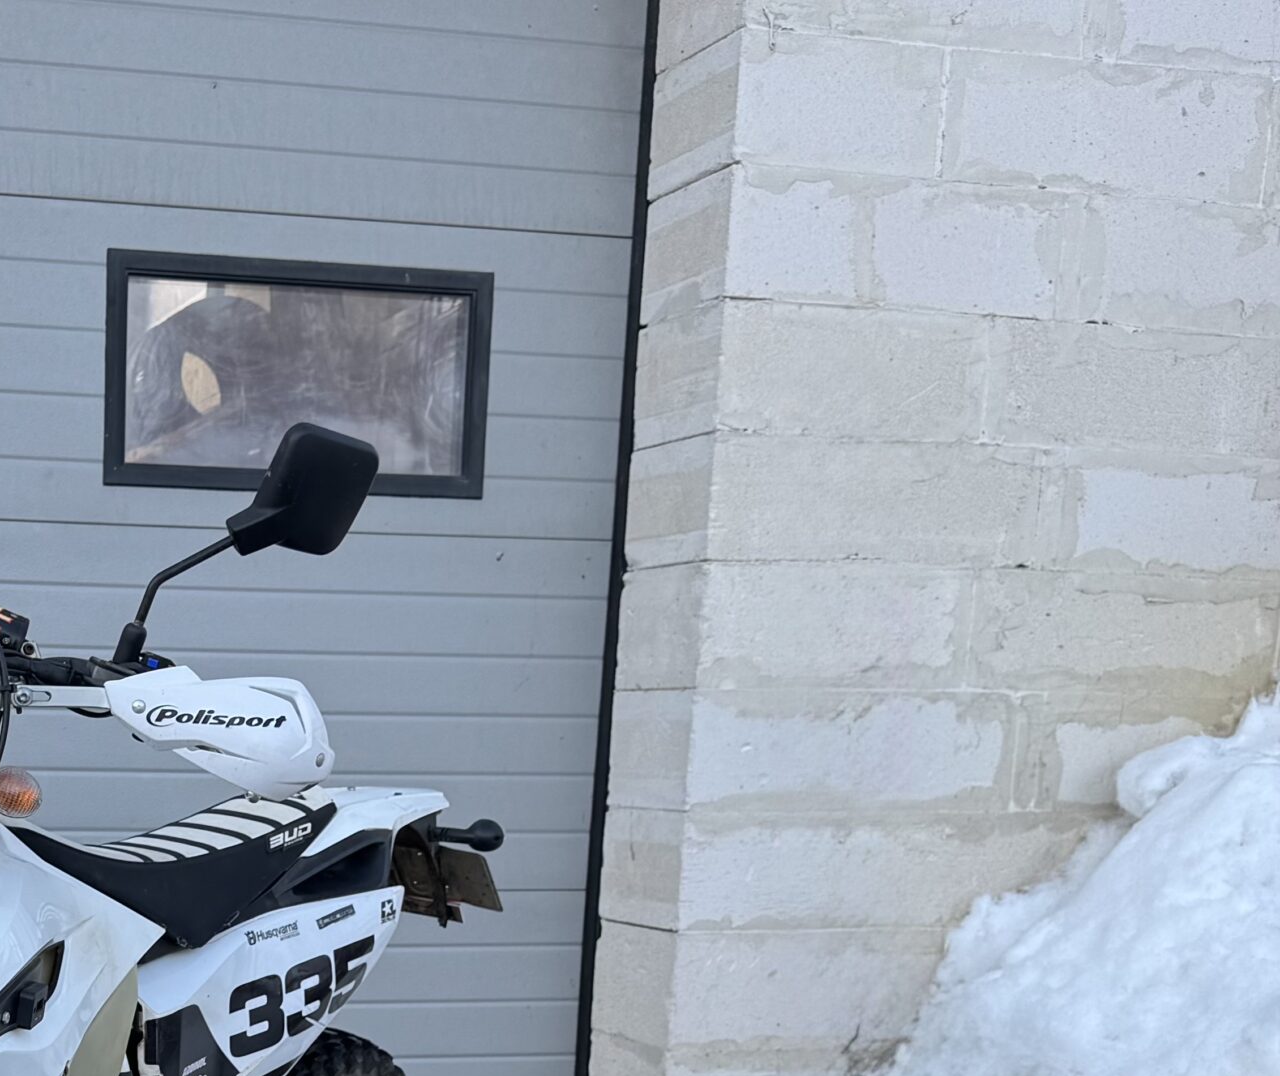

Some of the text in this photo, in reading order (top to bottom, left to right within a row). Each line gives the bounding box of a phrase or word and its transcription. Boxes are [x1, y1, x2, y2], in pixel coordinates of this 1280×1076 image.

[146, 704, 287, 728] Polisport
[256, 920, 299, 942] Husqvarna
[229, 935, 375, 1058] 335
